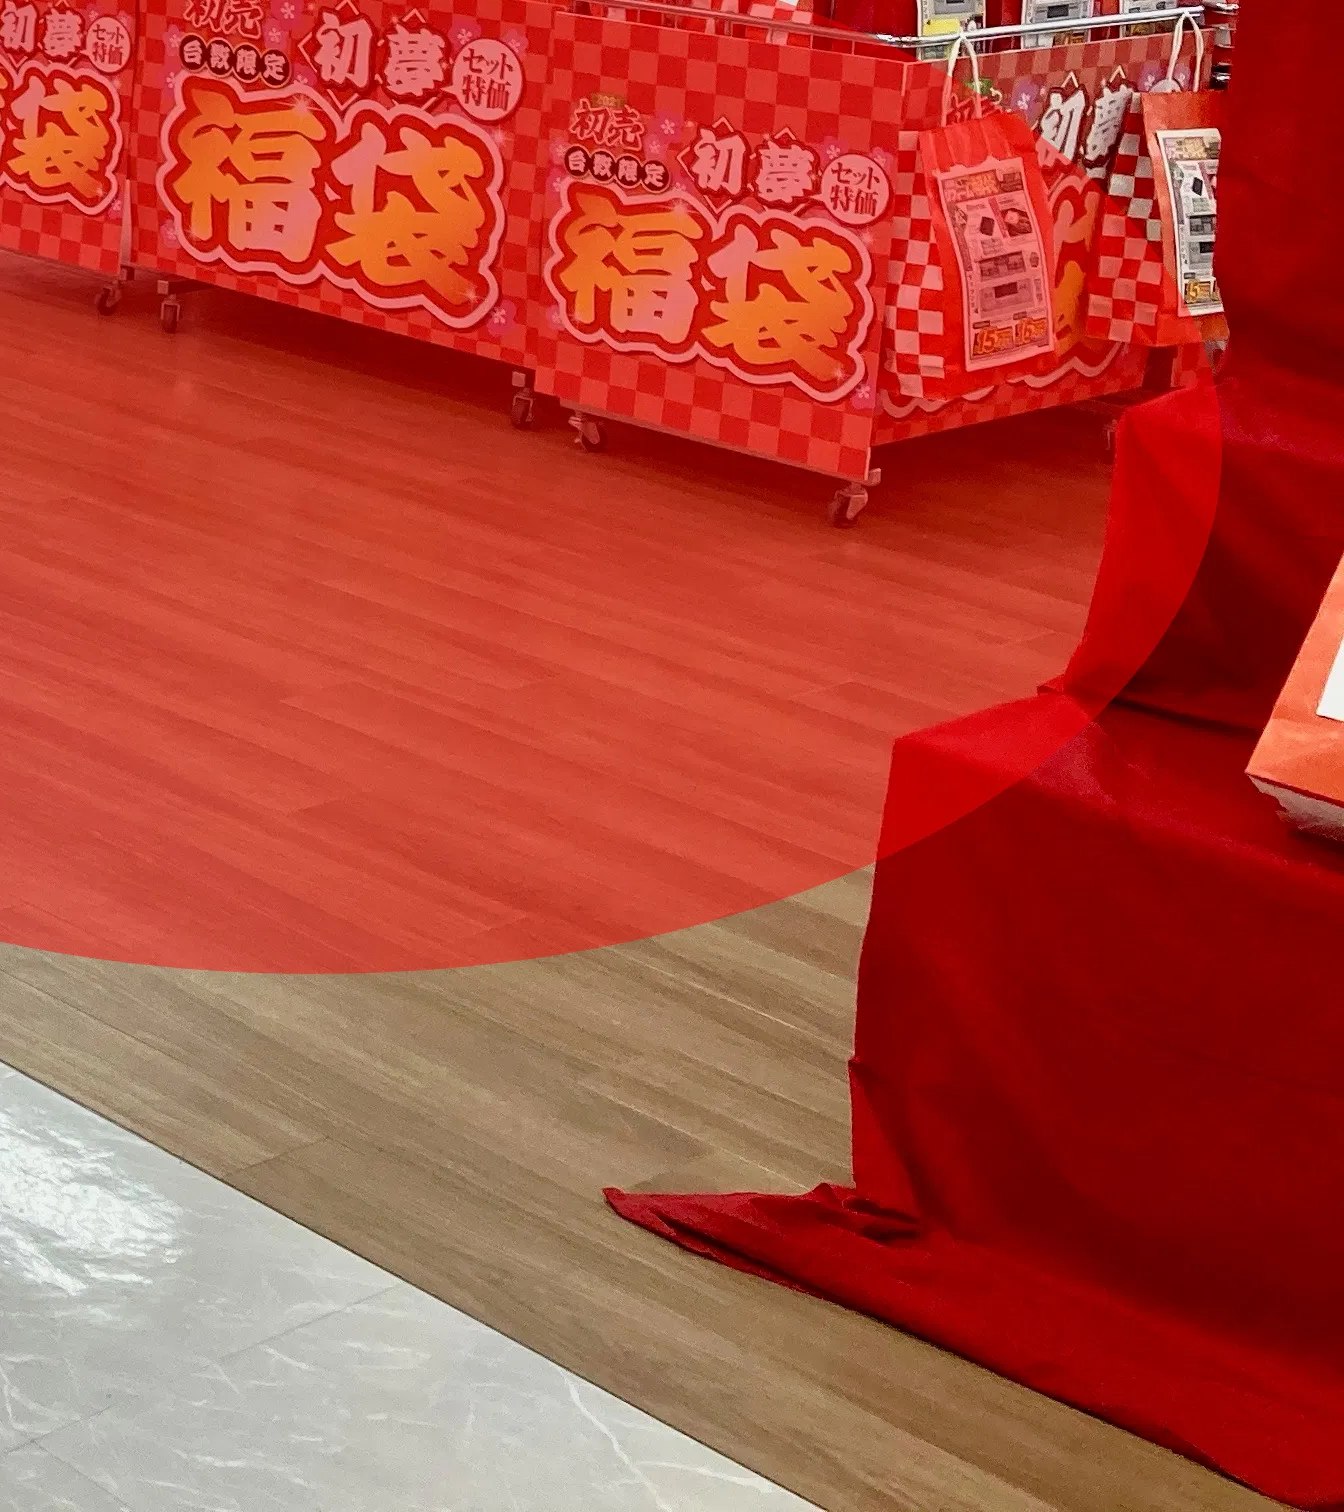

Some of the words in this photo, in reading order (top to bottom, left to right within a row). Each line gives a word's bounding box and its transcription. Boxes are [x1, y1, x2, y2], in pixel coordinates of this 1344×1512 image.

[0, 0, 85, 59] 初夢
[92, 24, 124, 44] セット
[92, 42, 124, 66] 特価
[182, 39, 287, 84] 台数限定
[314, 10, 447, 97] 初夢
[462, 49, 514, 77] セット
[462, 74, 511, 112] 特価
[567, 149, 668, 189] 台数限定
[689, 127, 816, 204] 初夢
[831, 161, 880, 187] セット
[172, 87, 487, 306] 福袋
[829, 189, 878, 218] 特価
[559, 190, 855, 382] 福袋
